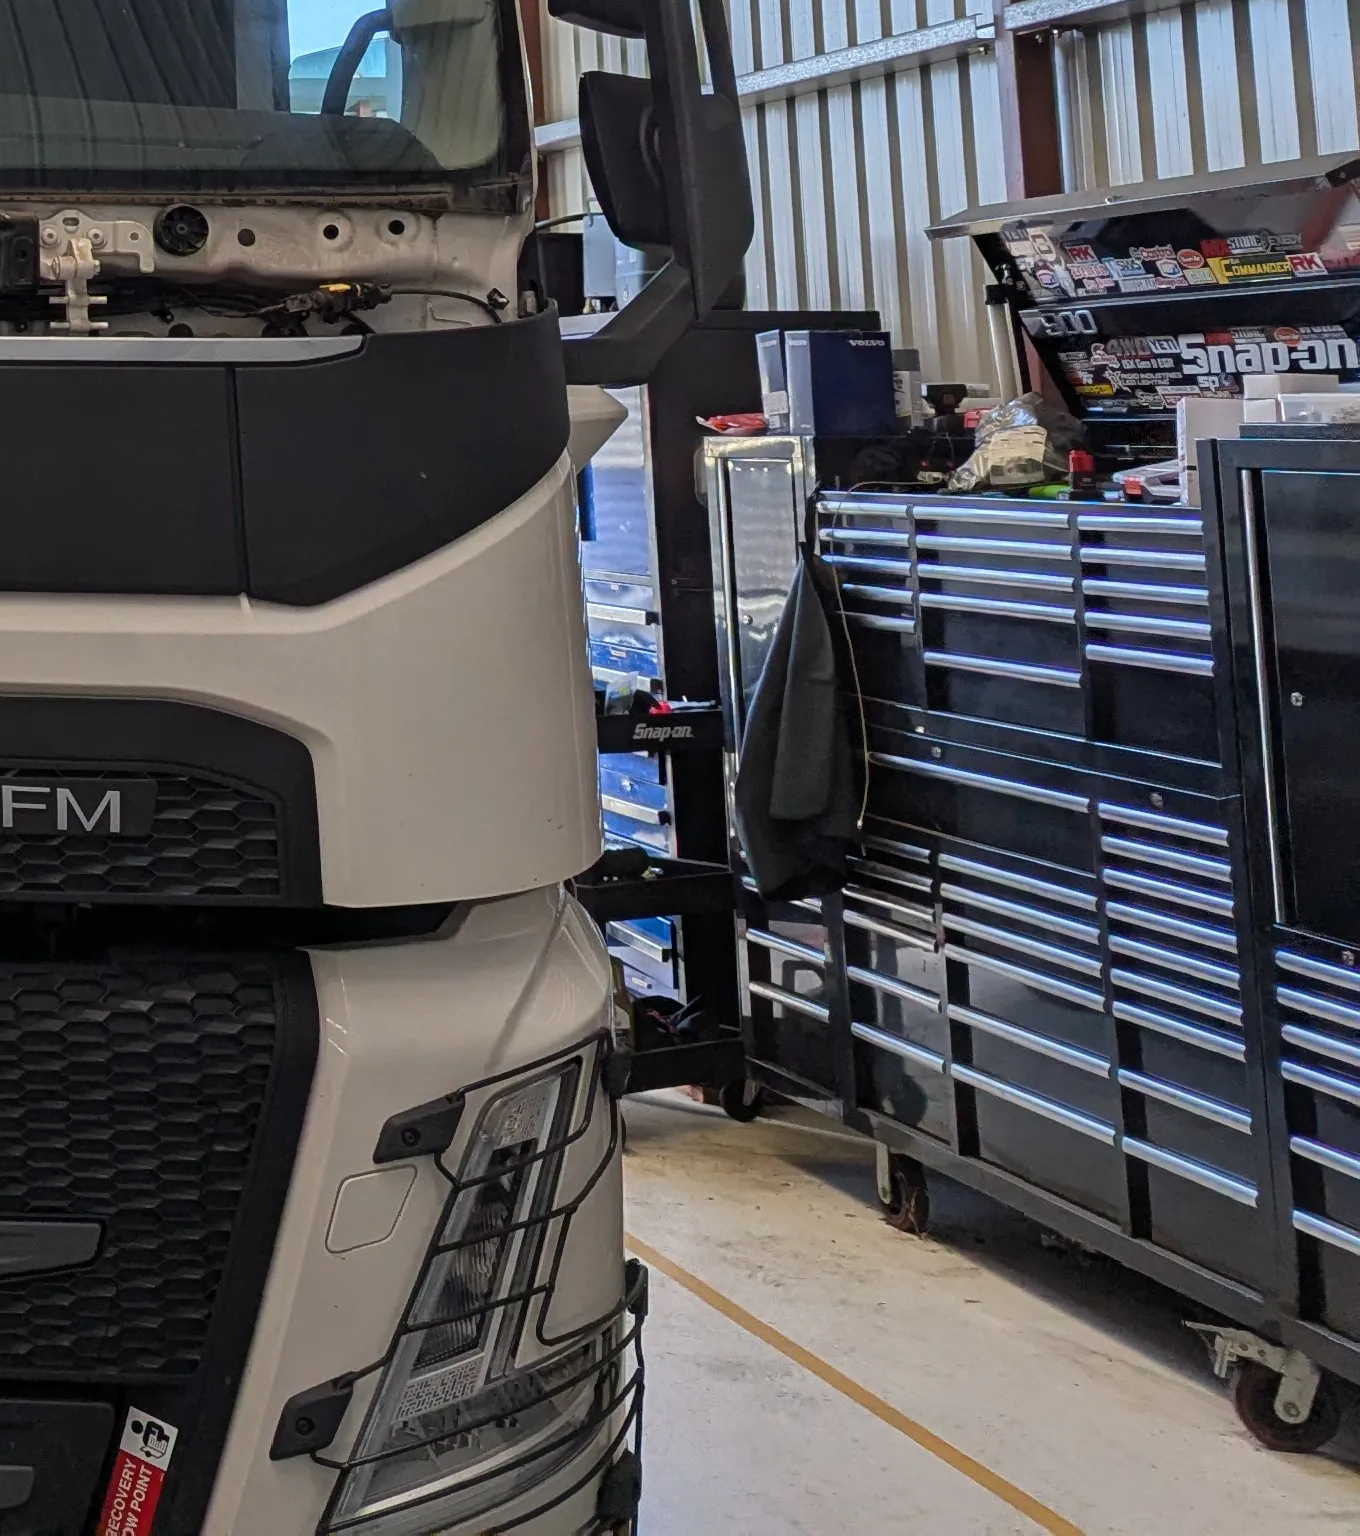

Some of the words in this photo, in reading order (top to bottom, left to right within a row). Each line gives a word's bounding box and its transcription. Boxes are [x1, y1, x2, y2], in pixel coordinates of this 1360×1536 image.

[1068, 246, 1095, 262] RK
[1288, 254, 1322, 272] RK
[1222, 260, 1292, 278] COMMANDER
[848, 339, 886, 347] VOLVO
[1106, 338, 1152, 357] 4WD
[1178, 333, 1360, 375] Snap-on
[632, 723, 693, 742] Snap-on
[1, 784, 121, 834] FM
[120, 1512, 139, 1536] OW
[130, 1464, 153, 1512] POINT
